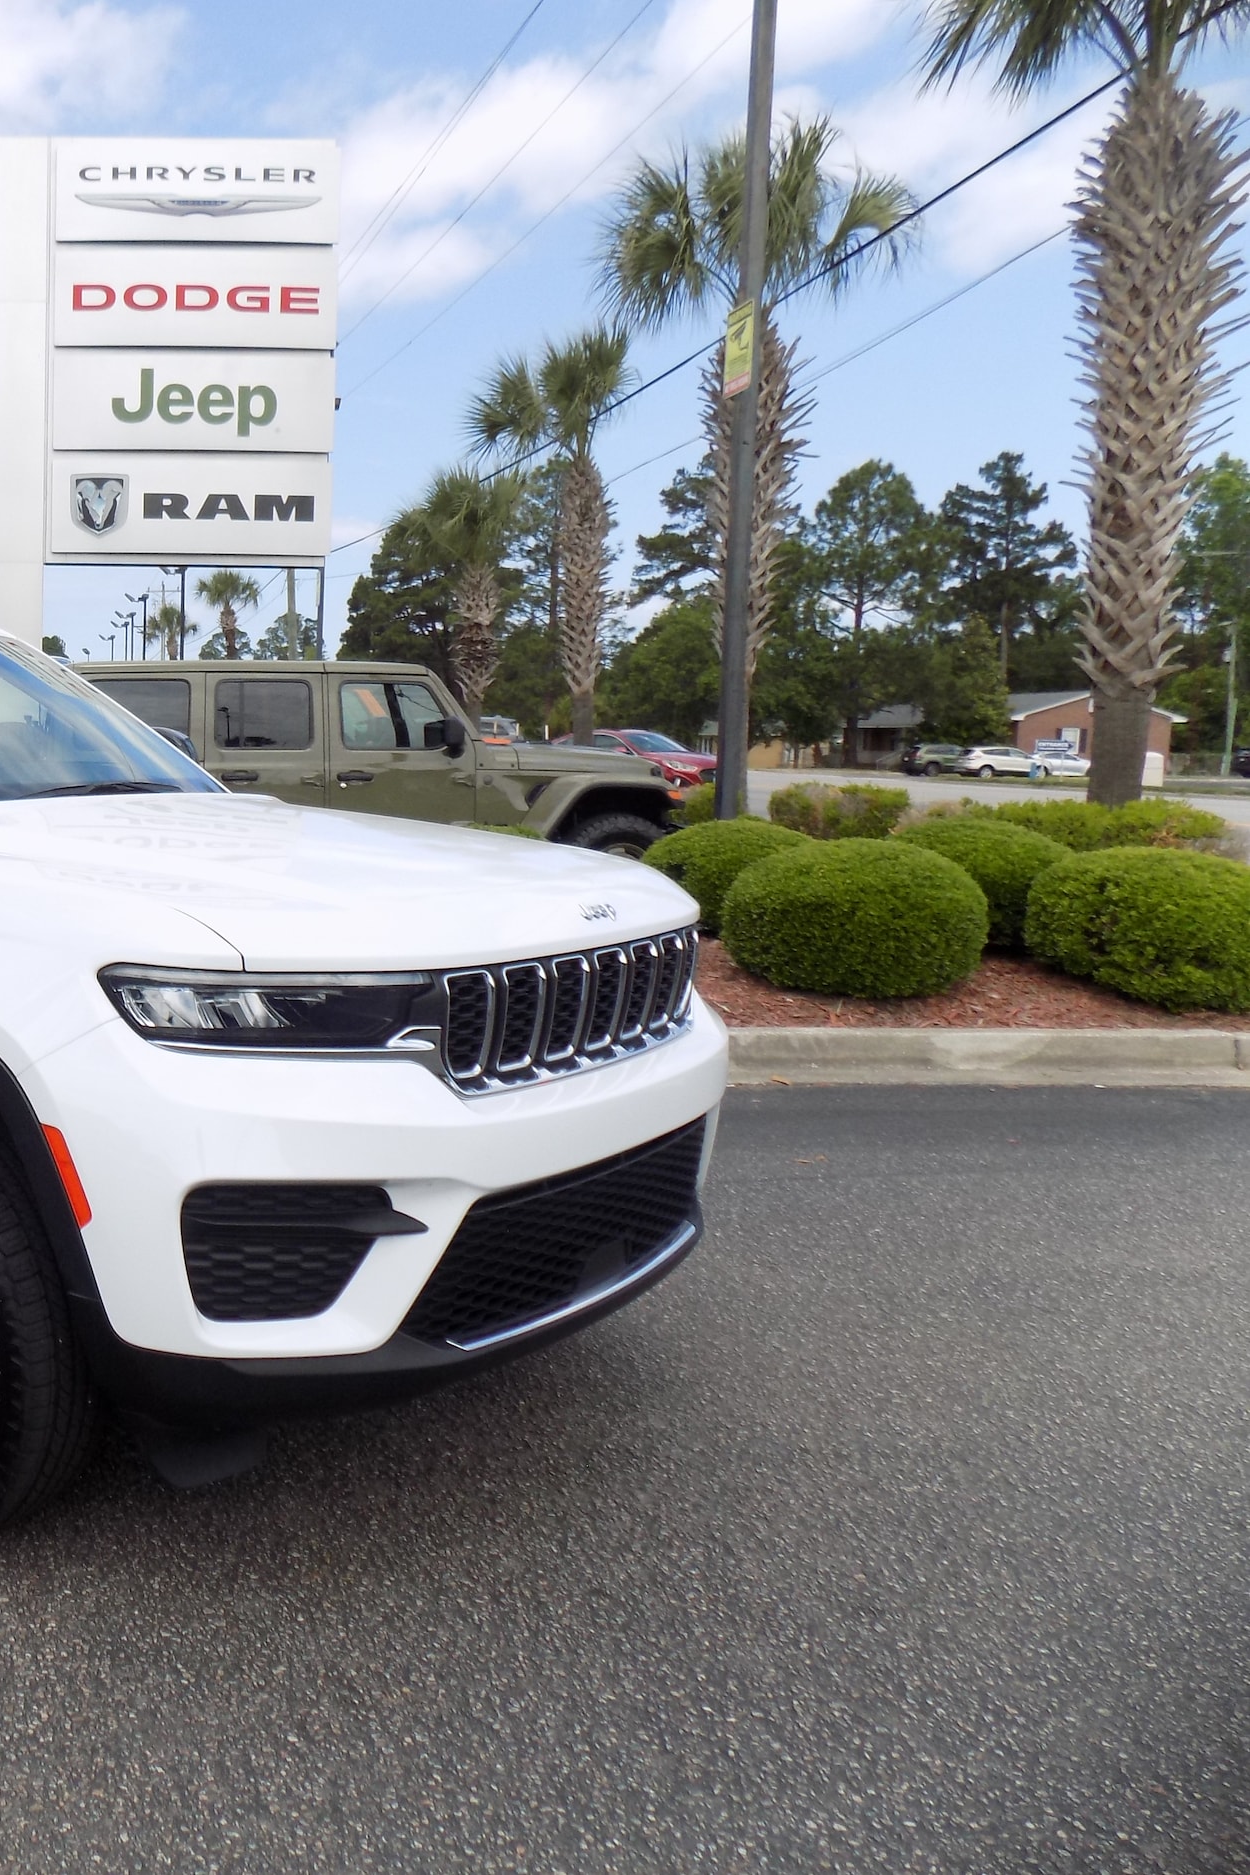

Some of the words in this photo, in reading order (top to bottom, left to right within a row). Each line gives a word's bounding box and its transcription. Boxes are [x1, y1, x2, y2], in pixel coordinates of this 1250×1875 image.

[78, 166, 316, 184] CHRYSLER
[72, 284, 320, 314] DODGE
[111, 368, 277, 437] Jeep
[143, 492, 315, 522] RAM
[578, 904, 617, 922] Jeep
